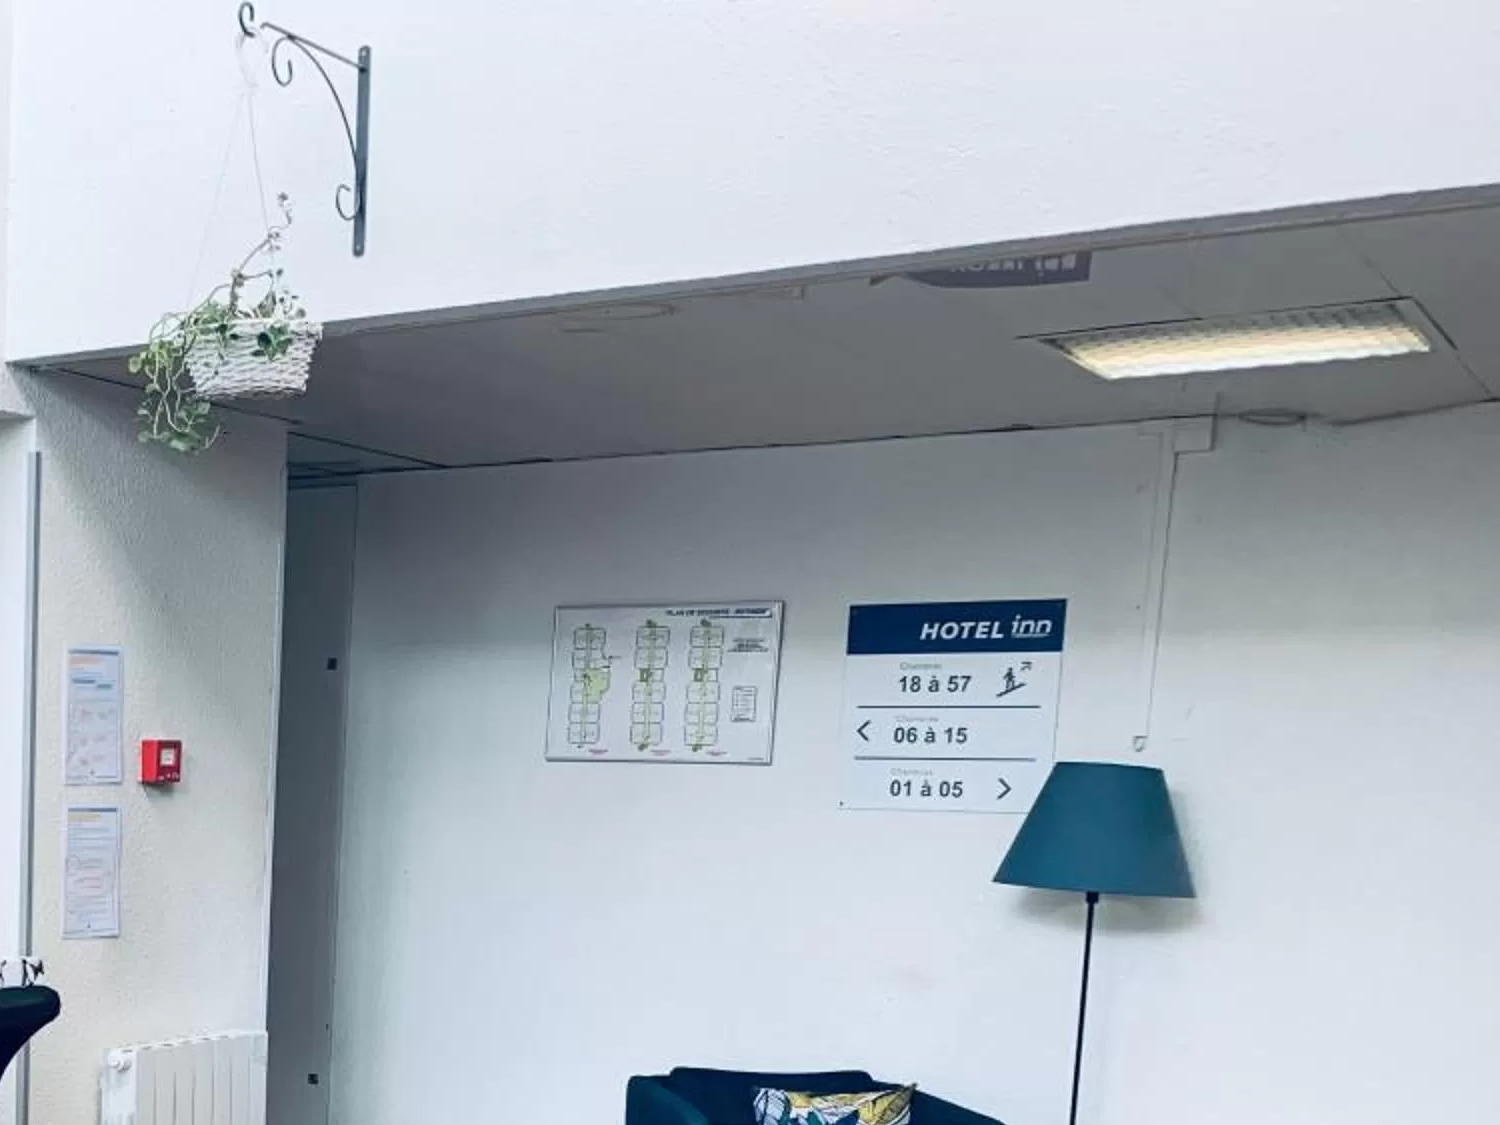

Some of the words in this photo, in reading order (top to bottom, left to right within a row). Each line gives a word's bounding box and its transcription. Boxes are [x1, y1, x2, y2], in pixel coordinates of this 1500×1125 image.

[919, 621, 1004, 641] HOTEL
[1011, 614, 1053, 638] inn
[899, 675, 921, 693] 18
[928, 675, 940, 693] à
[947, 675, 972, 693] 57
[894, 727, 918, 744] 06
[924, 726, 936, 744] à
[944, 727, 968, 744] 15
[890, 779, 912, 797] 01
[920, 779, 932, 797] à
[939, 780, 963, 798] 05
